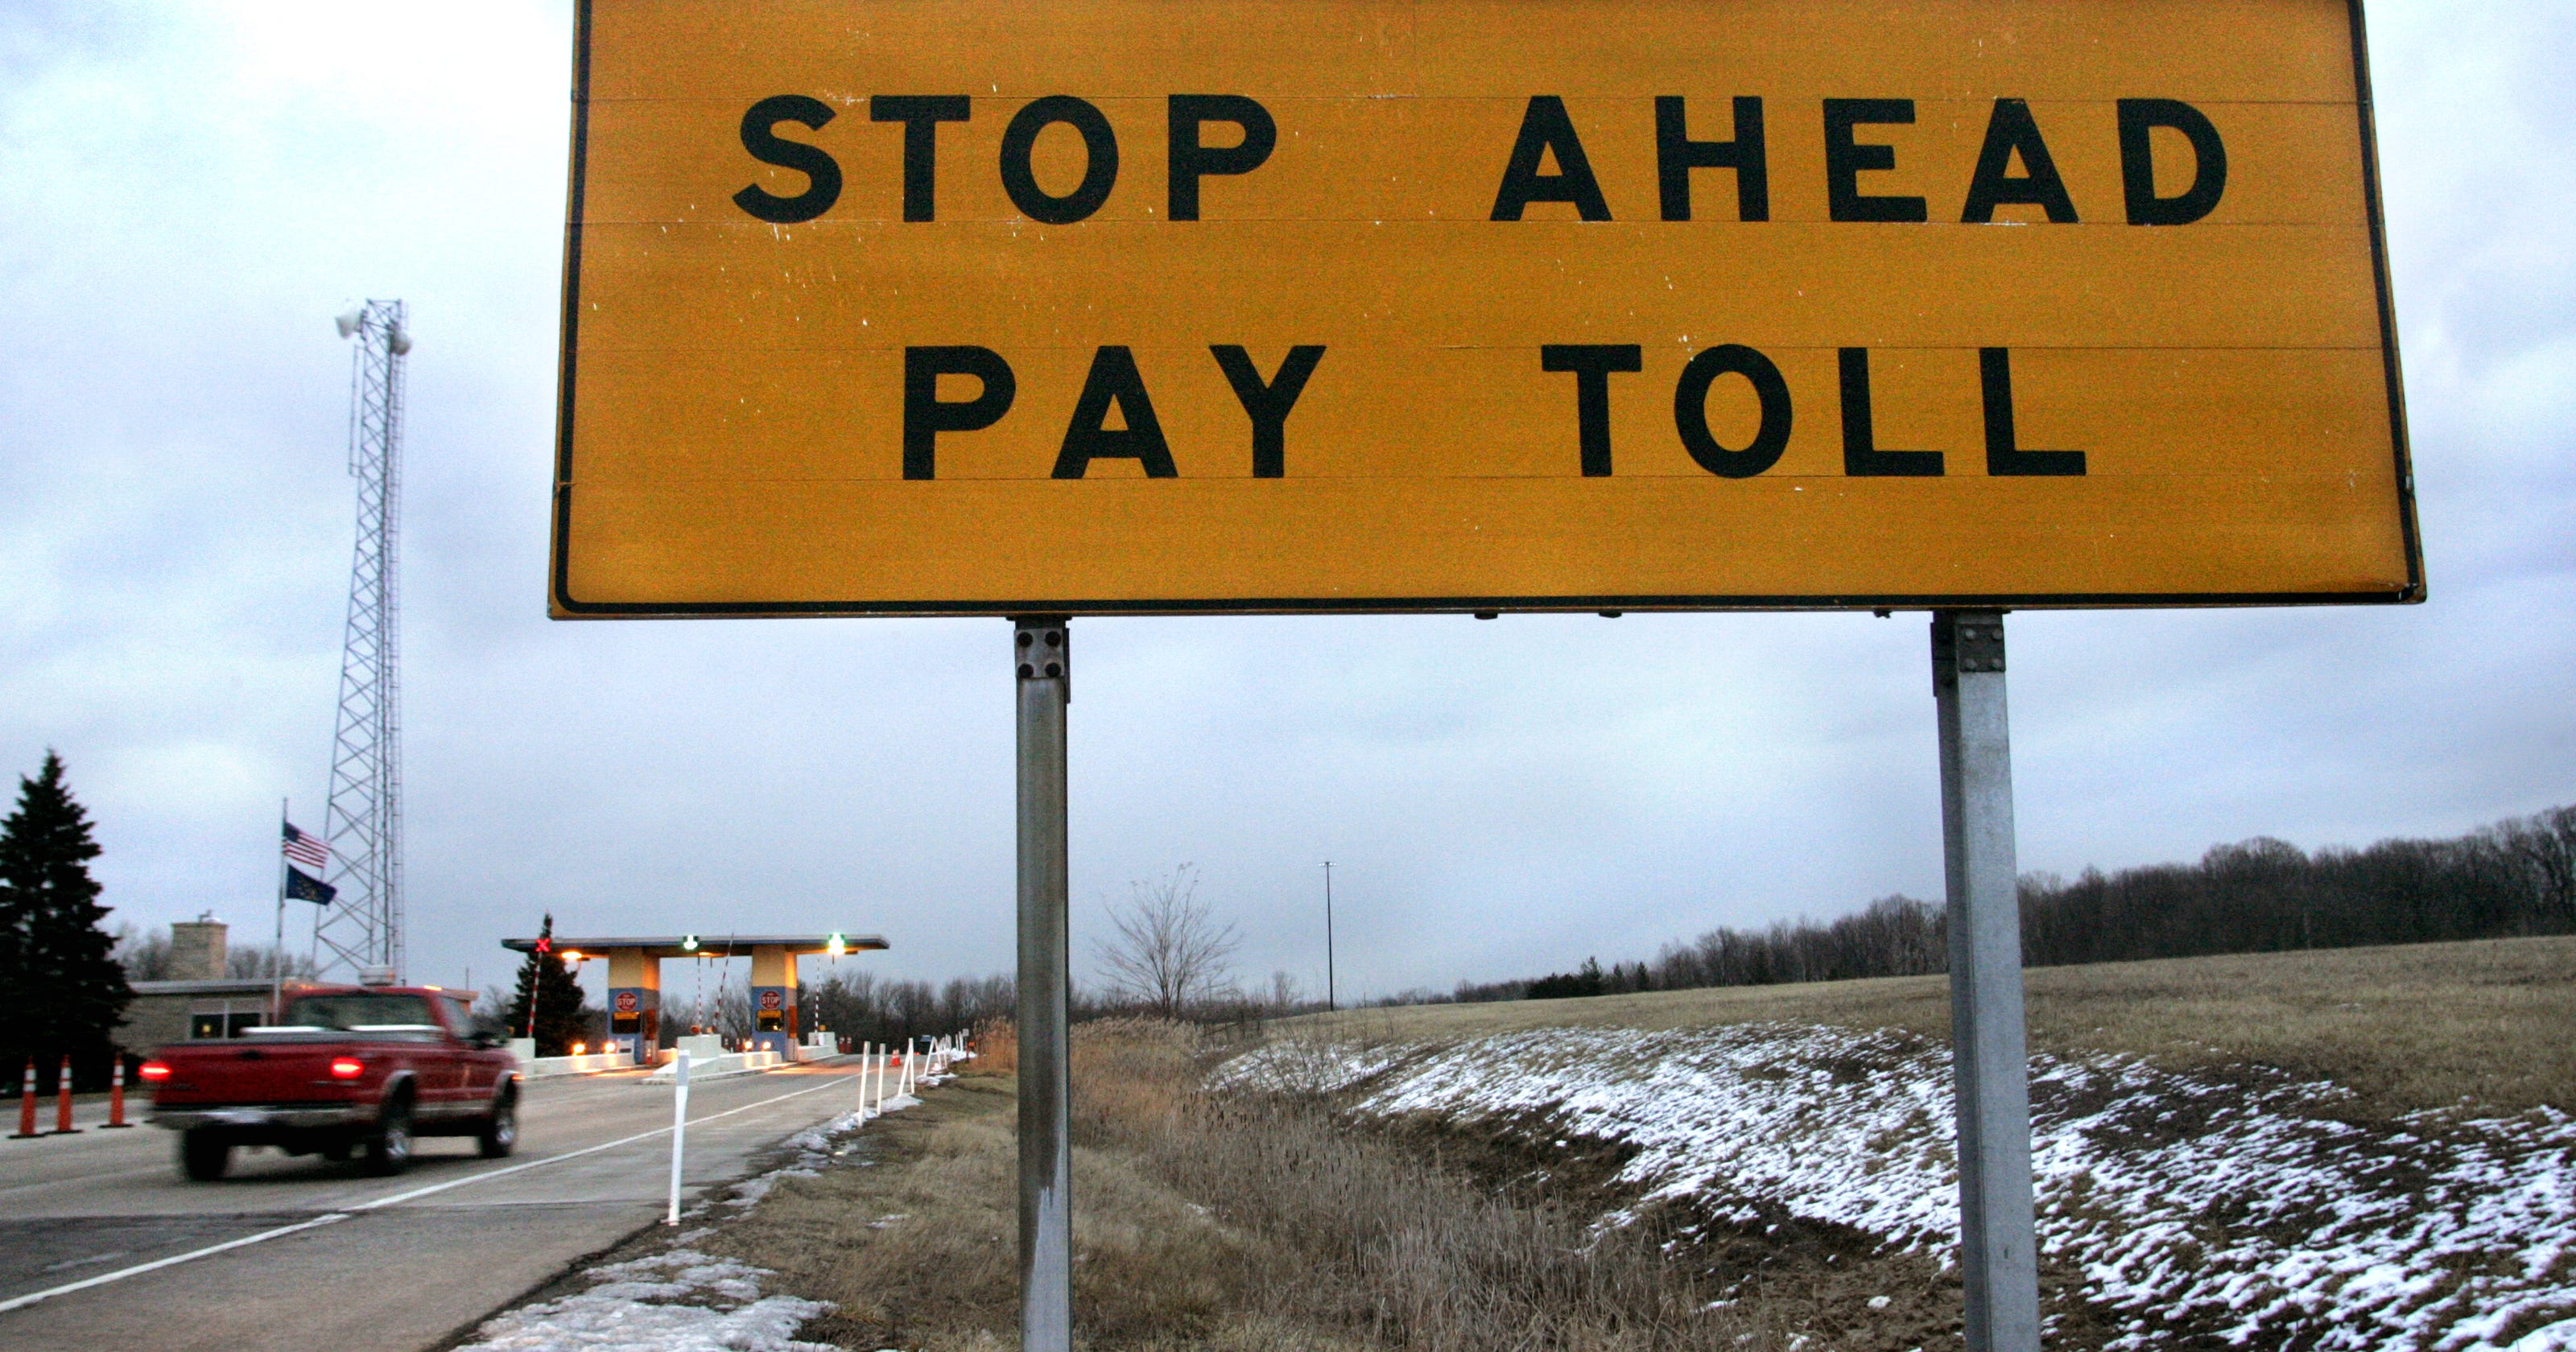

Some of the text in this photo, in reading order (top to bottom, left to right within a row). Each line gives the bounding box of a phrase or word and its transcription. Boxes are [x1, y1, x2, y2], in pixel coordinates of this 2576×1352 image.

[733, 94, 2227, 226] STOP AHEAD
[902, 344, 2087, 480] PAY TOLL
[617, 998, 636, 1006] STOP
[762, 996, 780, 1004] STOP
